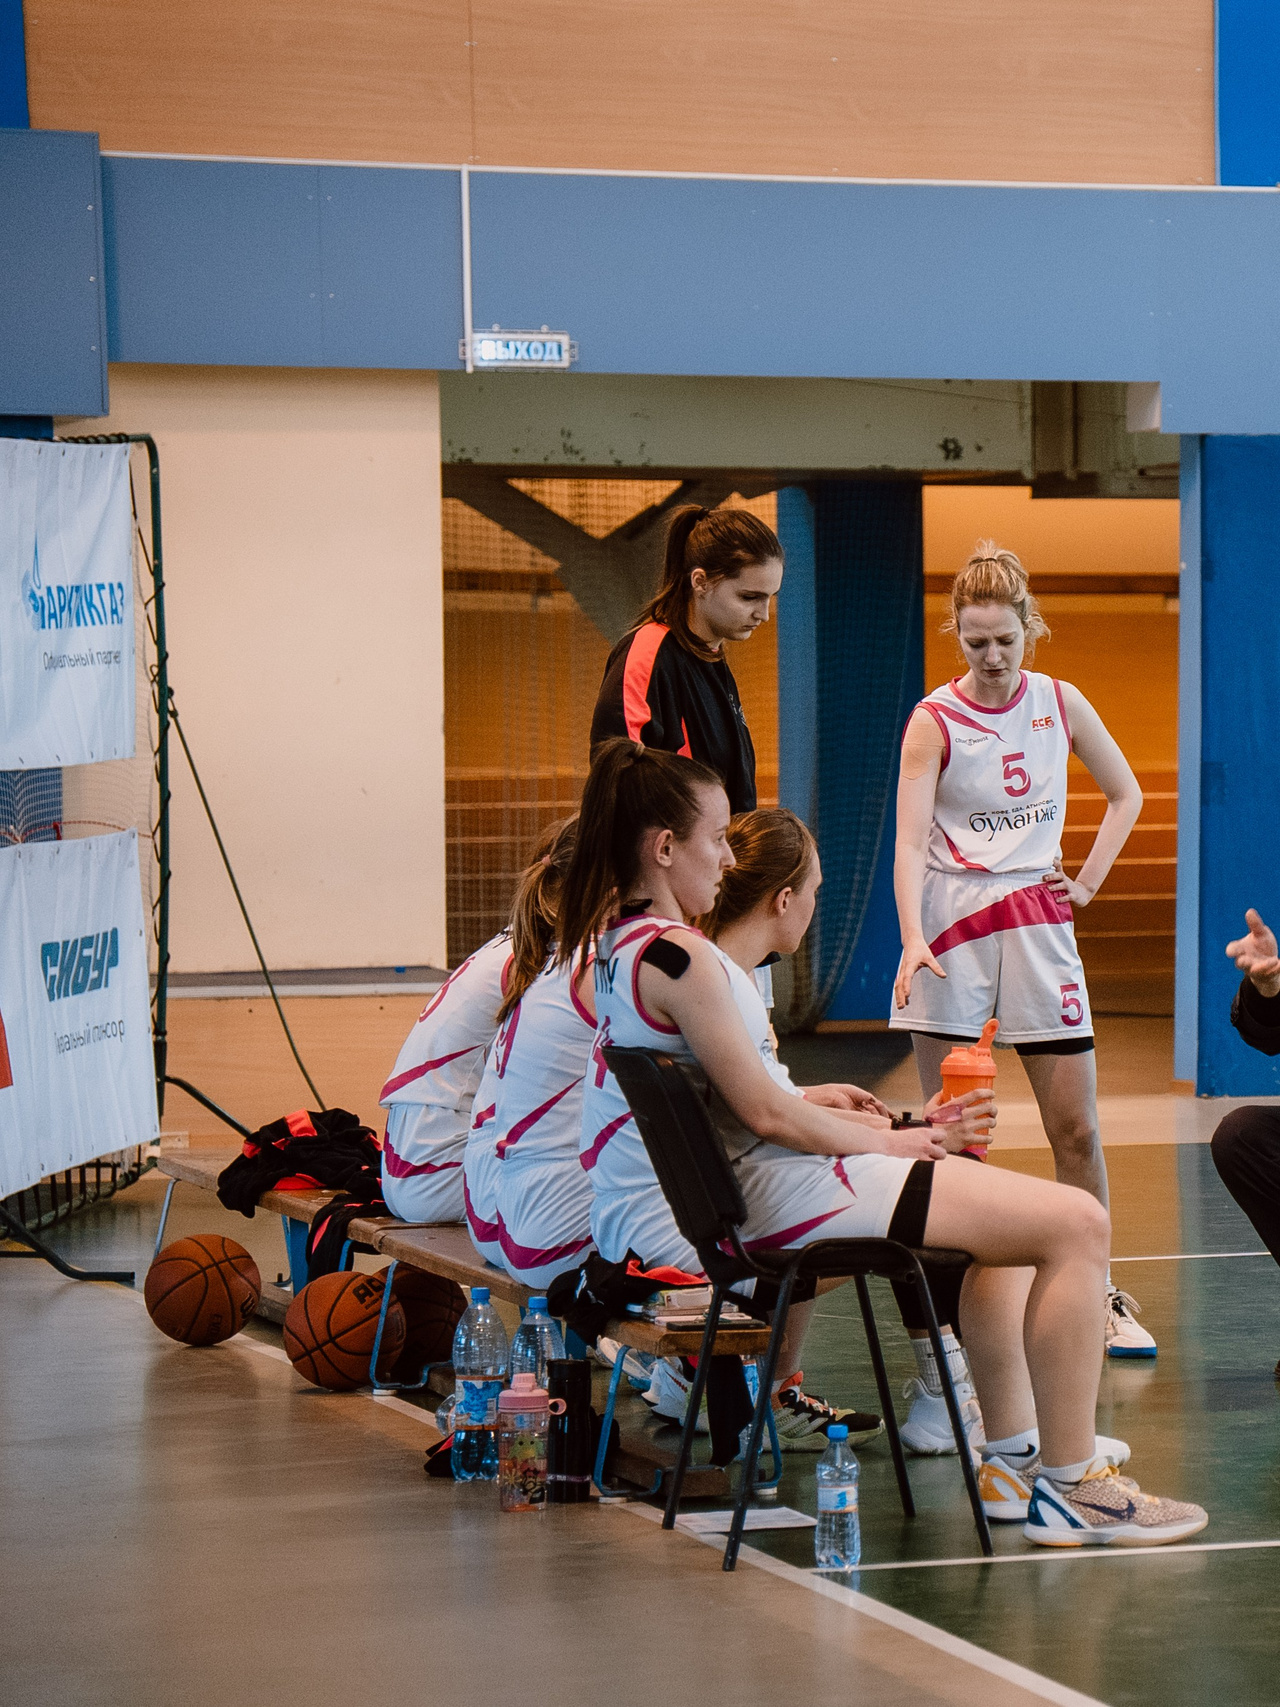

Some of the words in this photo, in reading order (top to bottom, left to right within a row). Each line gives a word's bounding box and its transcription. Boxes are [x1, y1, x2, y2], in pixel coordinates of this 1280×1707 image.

[1002, 751, 1032, 798] 5
[968, 805, 1058, 842] буланже
[41, 927, 119, 1002] СИБУР
[1059, 982, 1084, 1027] 5
